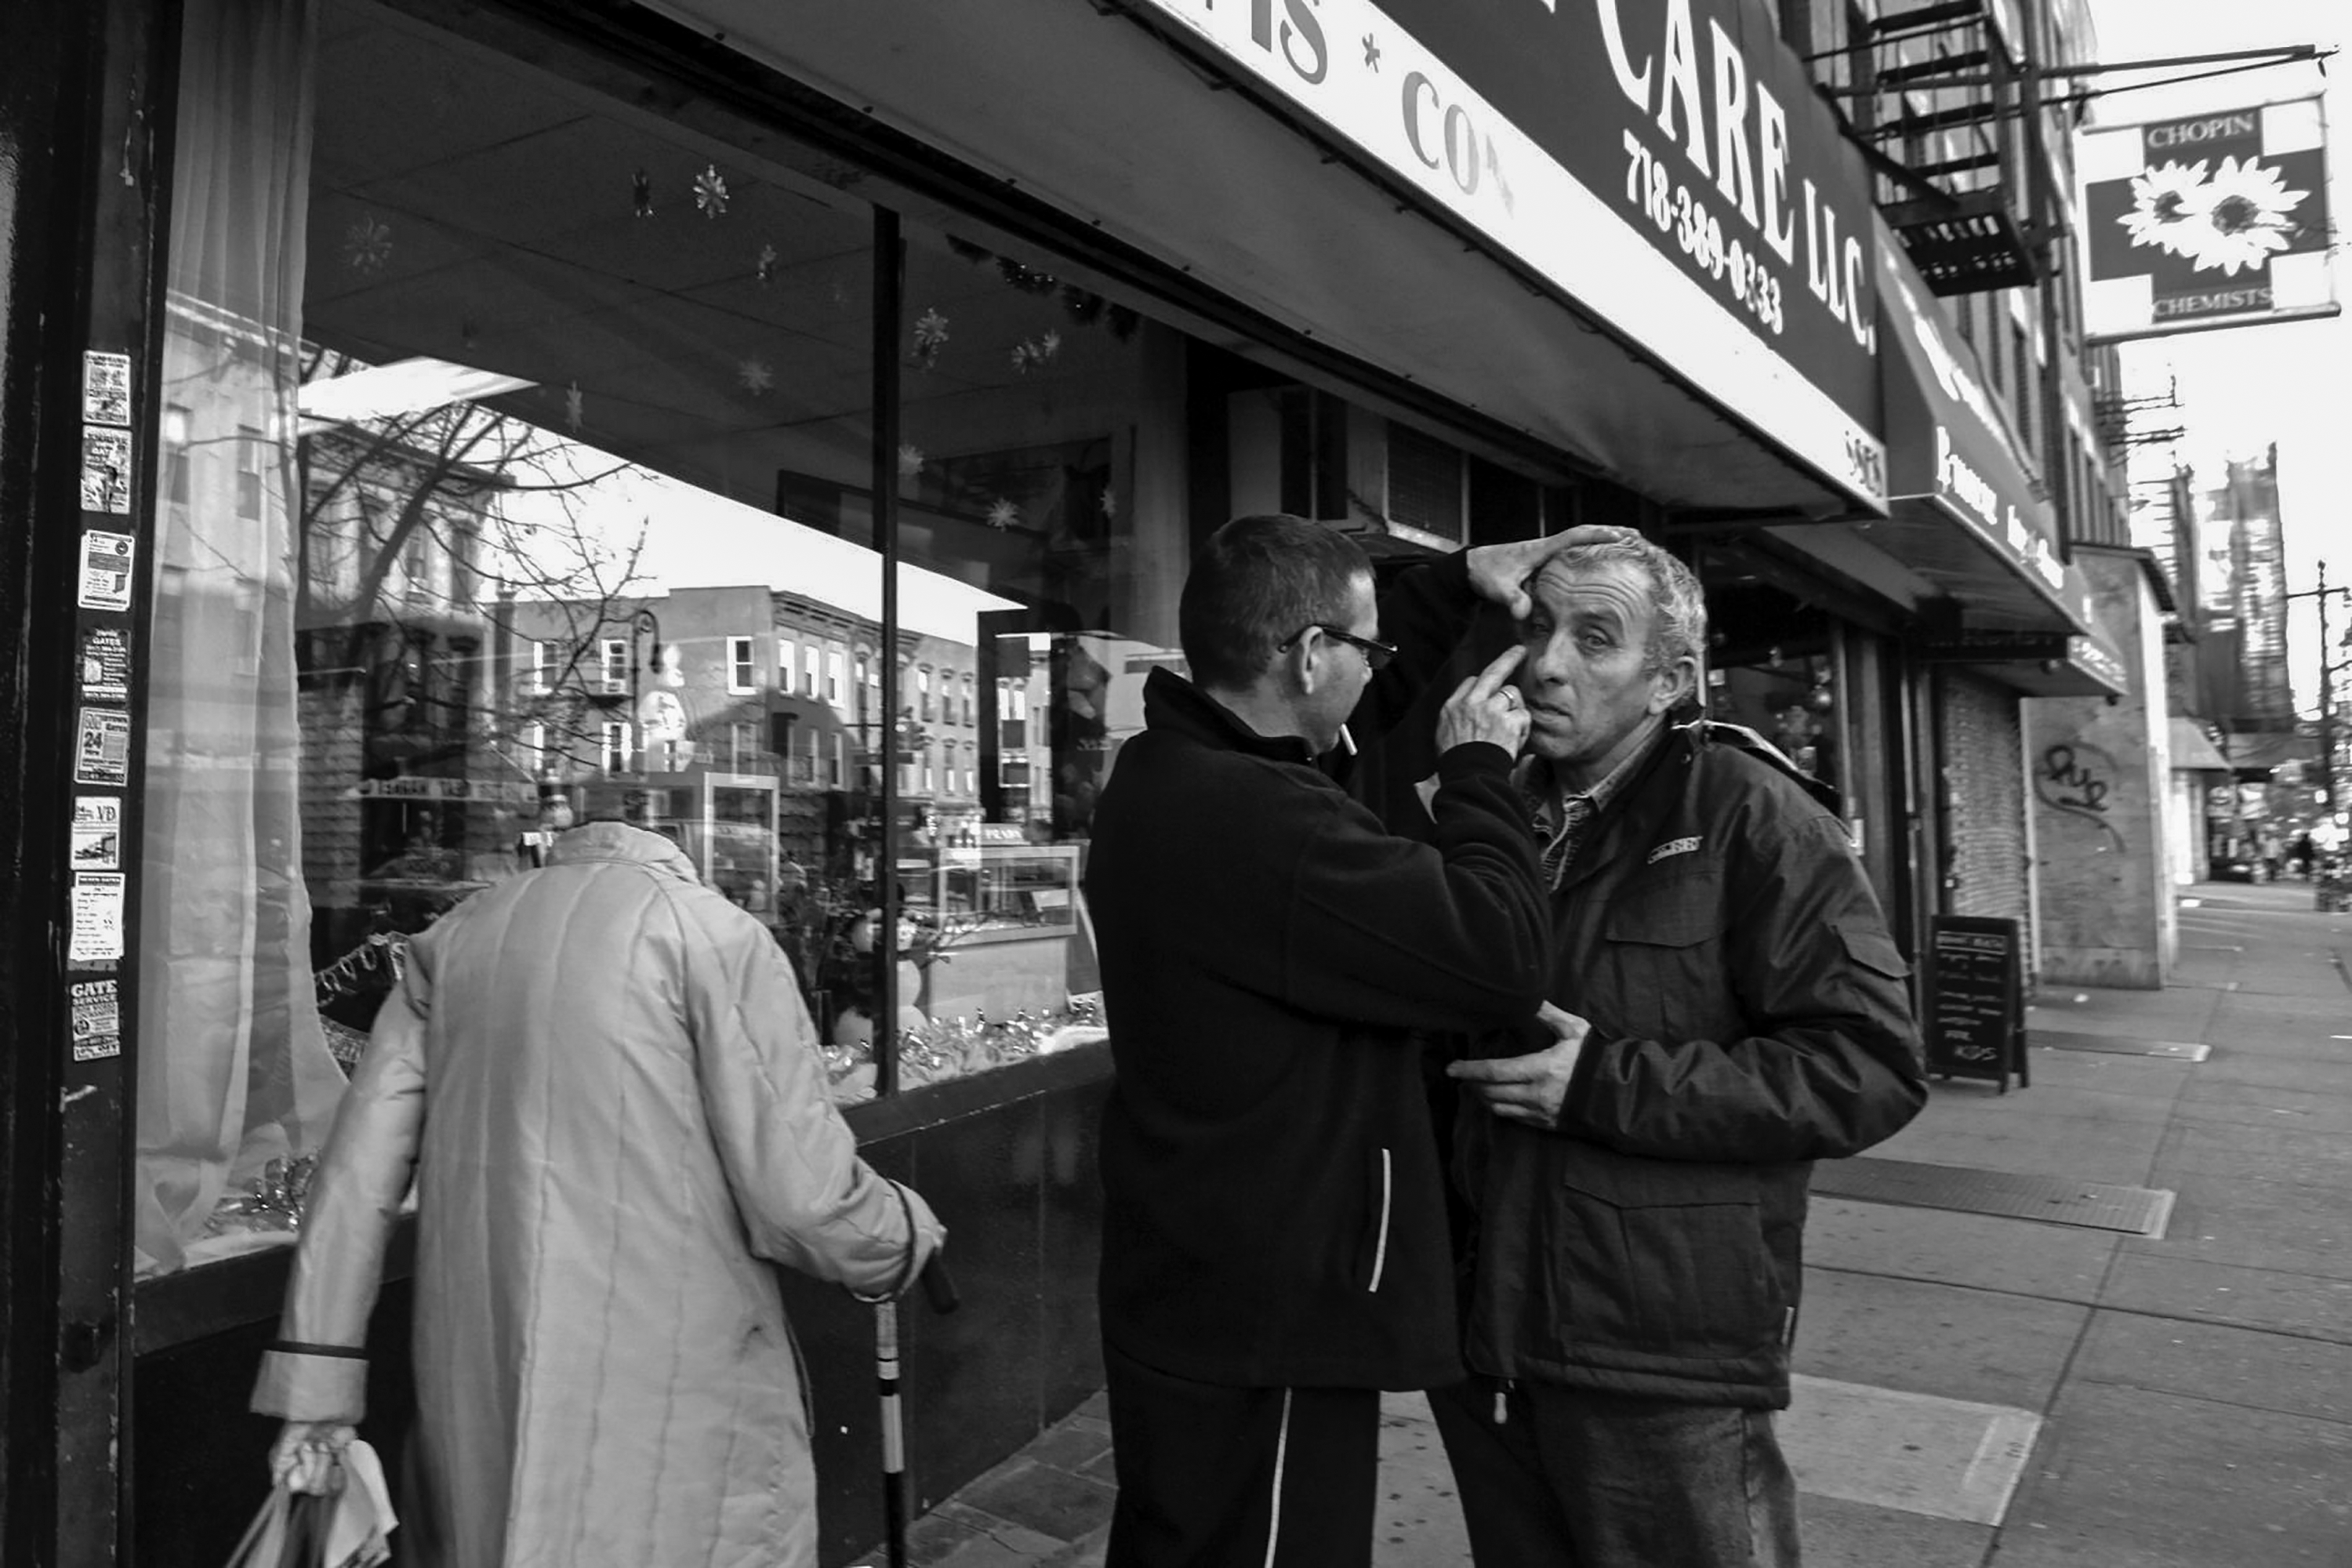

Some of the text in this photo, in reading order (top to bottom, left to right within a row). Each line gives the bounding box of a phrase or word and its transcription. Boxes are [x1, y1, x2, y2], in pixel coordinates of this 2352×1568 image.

[1595, 0, 1795, 267] CARE
[2147, 114, 2256, 149] CHOPIN
[1623, 128, 1784, 336] 718-389-0333
[2153, 287, 2272, 317] CHEMISTS
